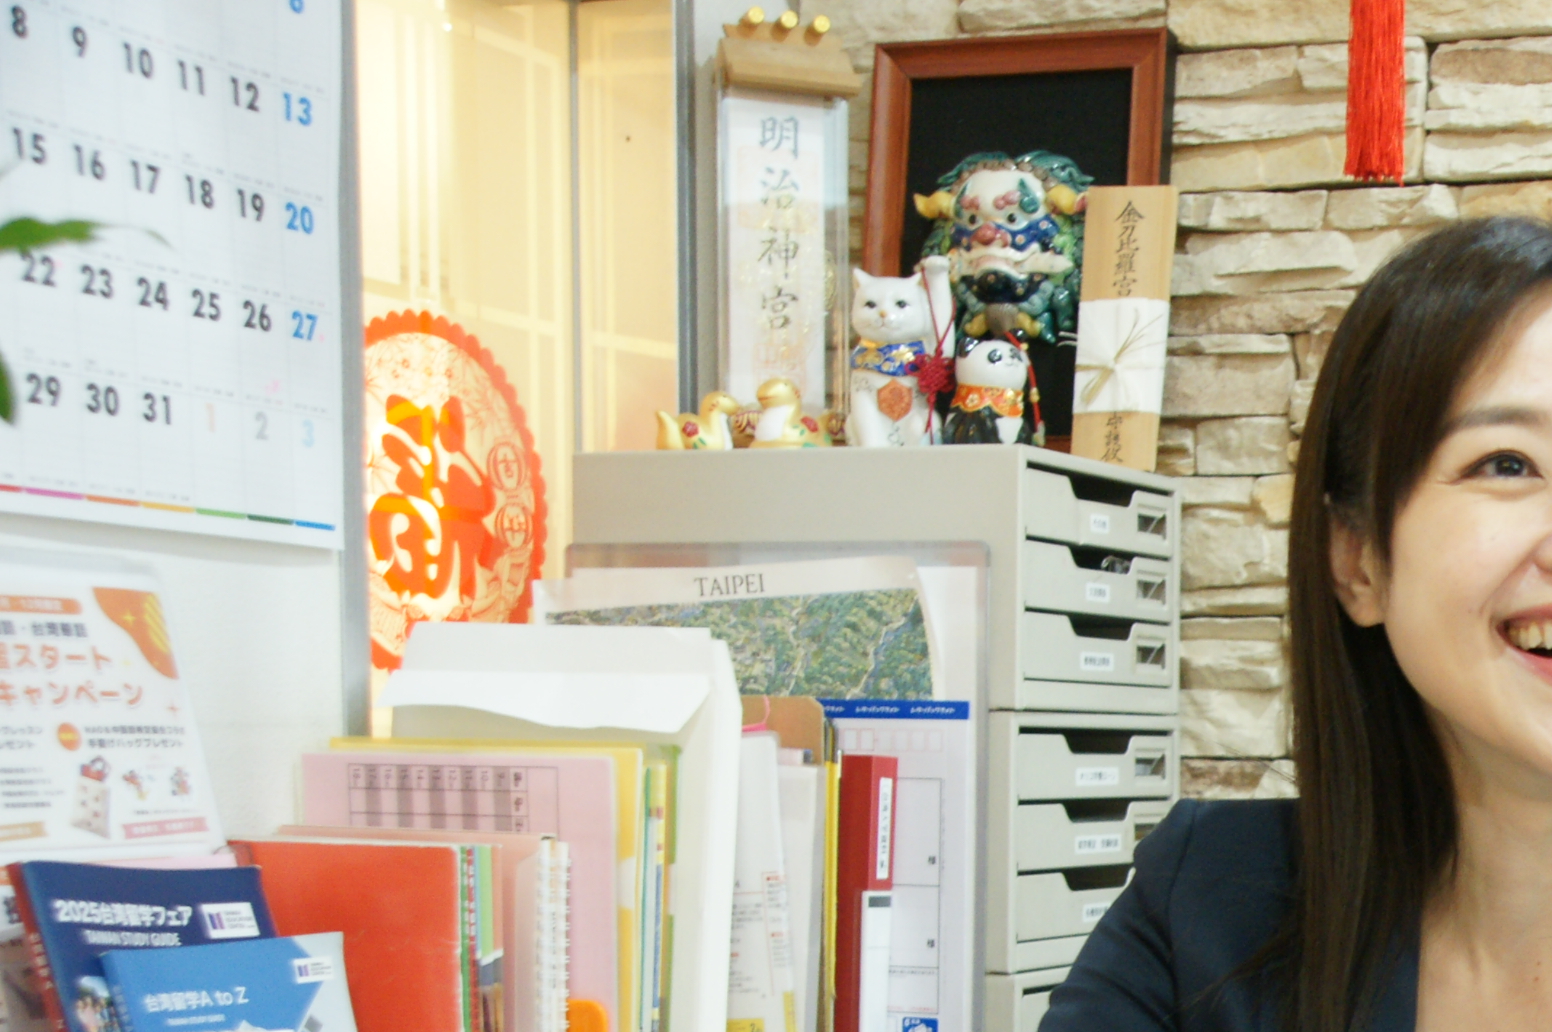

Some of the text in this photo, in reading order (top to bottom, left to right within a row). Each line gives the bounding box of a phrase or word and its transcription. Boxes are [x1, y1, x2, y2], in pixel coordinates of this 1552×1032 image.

[10, 5, 312, 126] 8 9 10 11 12 13
[13, 129, 314, 234] 15 16 17 18 19 20
[758, 116, 799, 329] 明治神宮
[20, 252, 318, 341] 22 23 24 25 26 27
[26, 374, 61, 406] 29
[86, 384, 119, 416] 30
[143, 394, 173, 425] 31
[694, 573, 765, 597] TAIPEI
